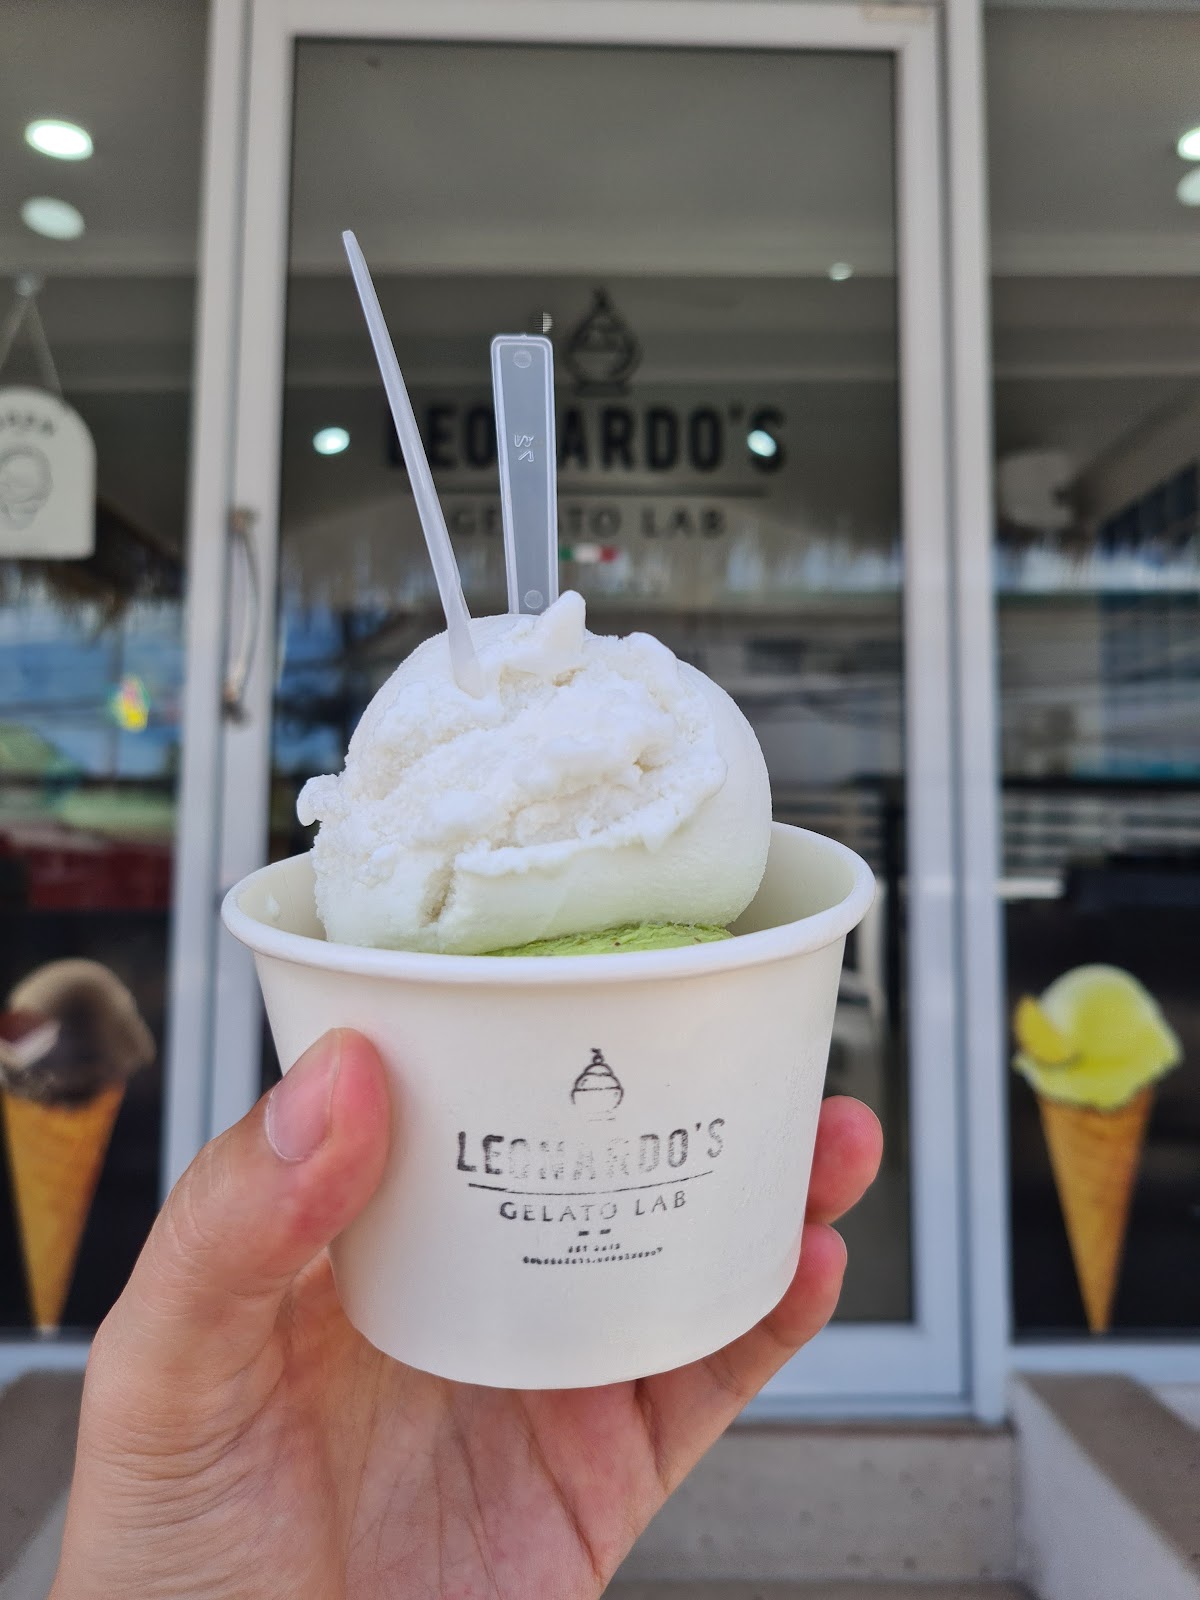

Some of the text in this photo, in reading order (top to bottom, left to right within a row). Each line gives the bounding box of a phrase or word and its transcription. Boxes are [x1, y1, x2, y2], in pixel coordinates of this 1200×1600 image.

[386, 403, 786, 473] LEOARDO'S
[450, 507, 726, 538] GETO LAB
[456, 1117, 726, 1180] LEONARDO'S
[499, 1190, 688, 1222] GELATO LAB
